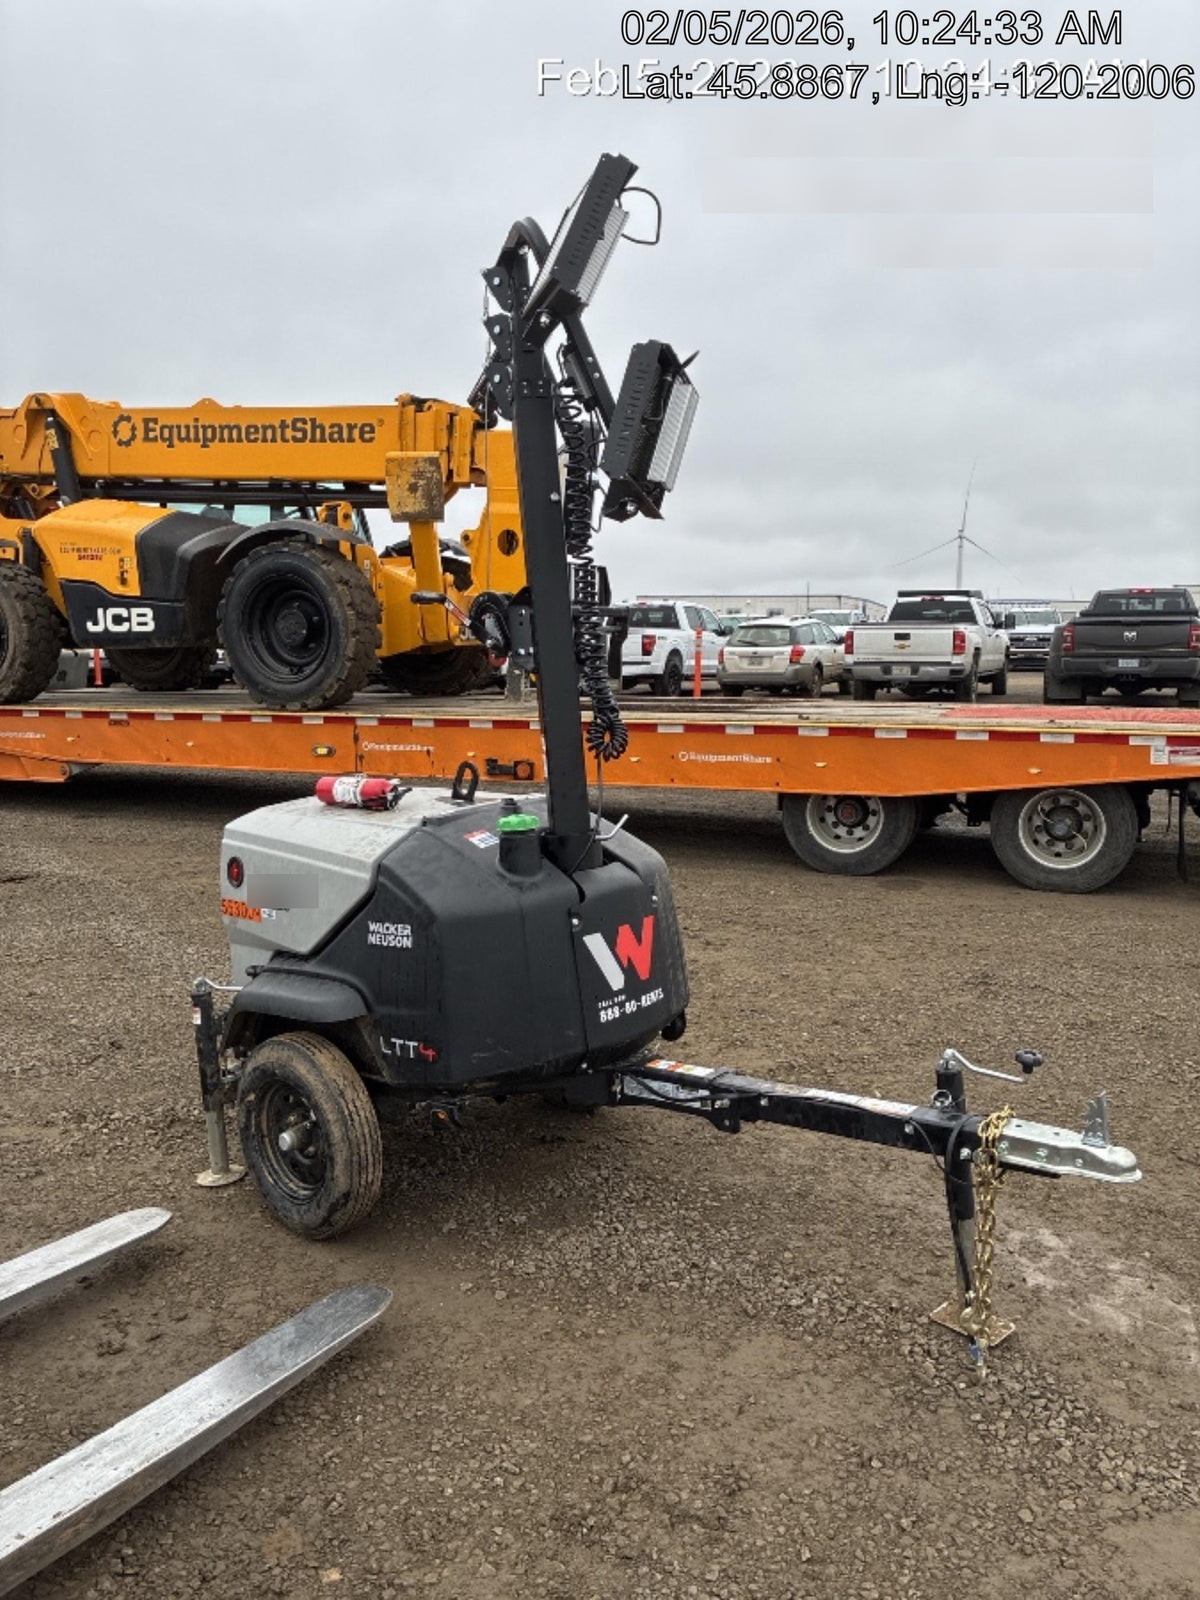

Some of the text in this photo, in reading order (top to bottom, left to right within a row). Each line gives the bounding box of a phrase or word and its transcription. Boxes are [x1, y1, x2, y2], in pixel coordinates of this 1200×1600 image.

[142, 417, 376, 448] EquipmentShare
[86, 607, 155, 632] JCB
[367, 933, 413, 948] NEUSON
[368, 921, 412, 935] WACKER
[380, 1036, 436, 1062] LTT4
